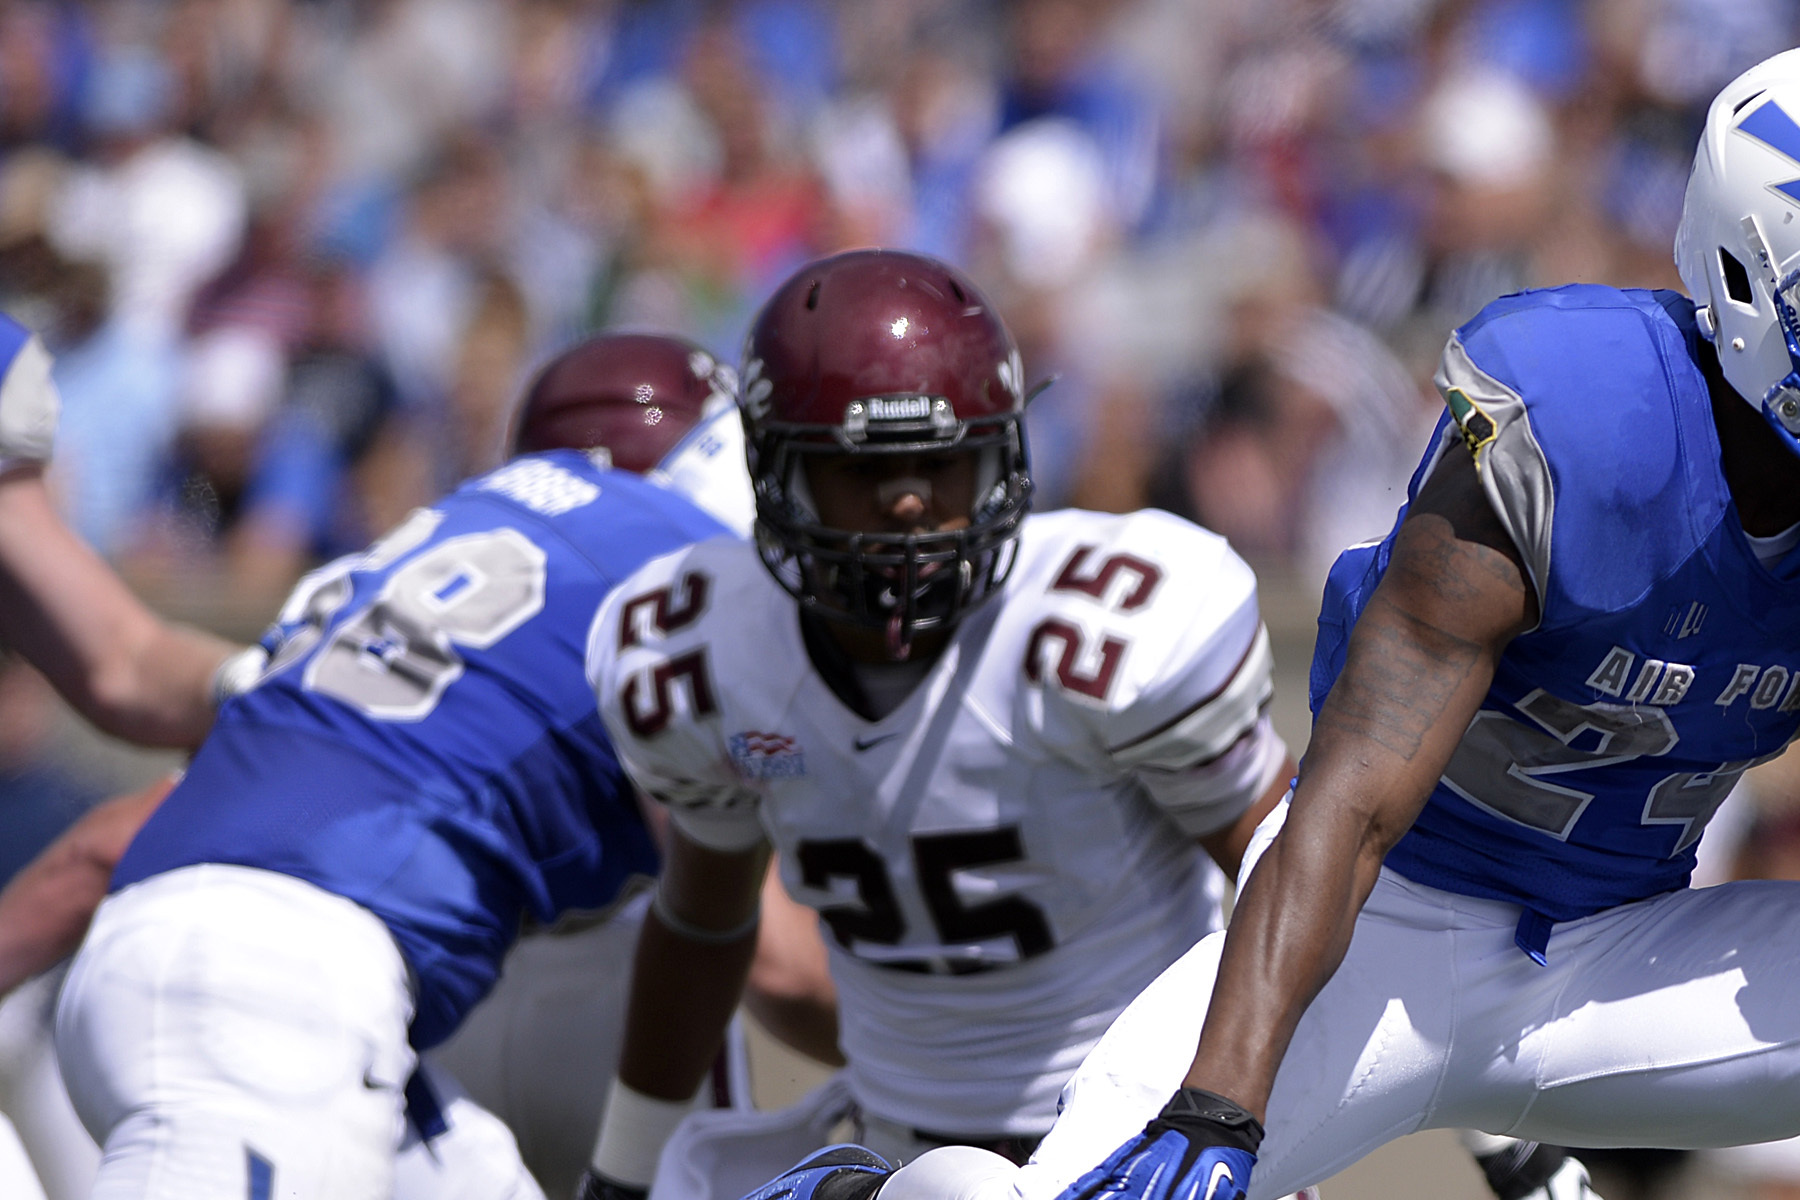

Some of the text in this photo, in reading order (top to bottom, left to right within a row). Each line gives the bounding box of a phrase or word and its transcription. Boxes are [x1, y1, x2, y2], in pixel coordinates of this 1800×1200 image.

[616, 570, 718, 738] 25
[1024, 543, 1168, 702] 25
[1585, 644, 1696, 706] AIR
[797, 823, 1057, 977] 25
